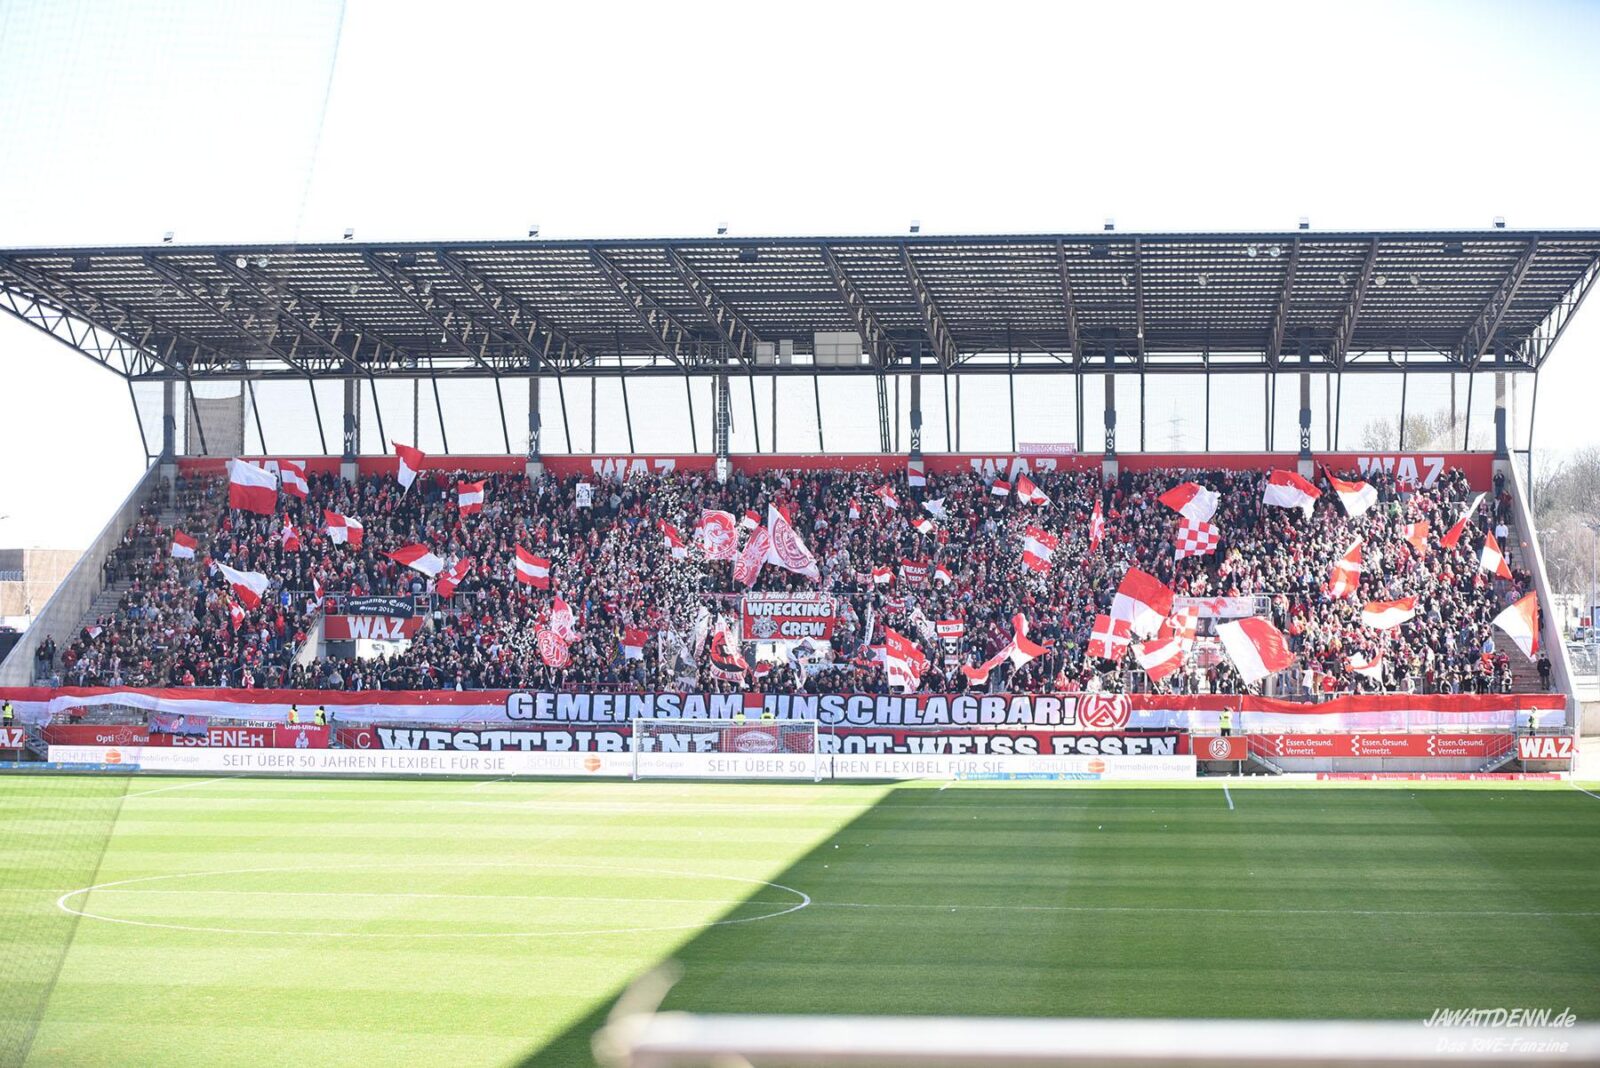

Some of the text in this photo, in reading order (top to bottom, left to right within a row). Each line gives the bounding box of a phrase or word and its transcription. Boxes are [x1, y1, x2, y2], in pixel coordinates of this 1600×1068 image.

[911, 438, 920, 450] 2
[1106, 438, 1114, 450] 3
[1301, 437, 1310, 449] 3
[1357, 457, 1445, 490] WAZ
[349, 598, 387, 606] ommando
[747, 602, 831, 617] WRECKING
[347, 616, 405, 639] WAZ
[781, 621, 825, 637] CREW
[506, 692, 1077, 725] GEMEINSAM UNSCHLAGBAR!
[96, 734, 115, 743] Opti
[1286, 747, 1316, 755] Vernetzt.
[1362, 747, 1391, 755] Vernetzt.
[1438, 747, 1467, 755] Vernetzt.
[1519, 737, 1573, 758] WAZ
[223, 752, 505, 770] SEIT ÜBER 50 JAHREN FLEXIBEL FÜR SIE
[708, 759, 738, 772] SEIT
[744, 757, 783, 773] ÜBER
[789, 760, 806, 773] 50
[811, 760, 870, 774] AHREN
[875, 761, 942, 773] FLEXIBEL
[949, 759, 977, 774] FÜR
